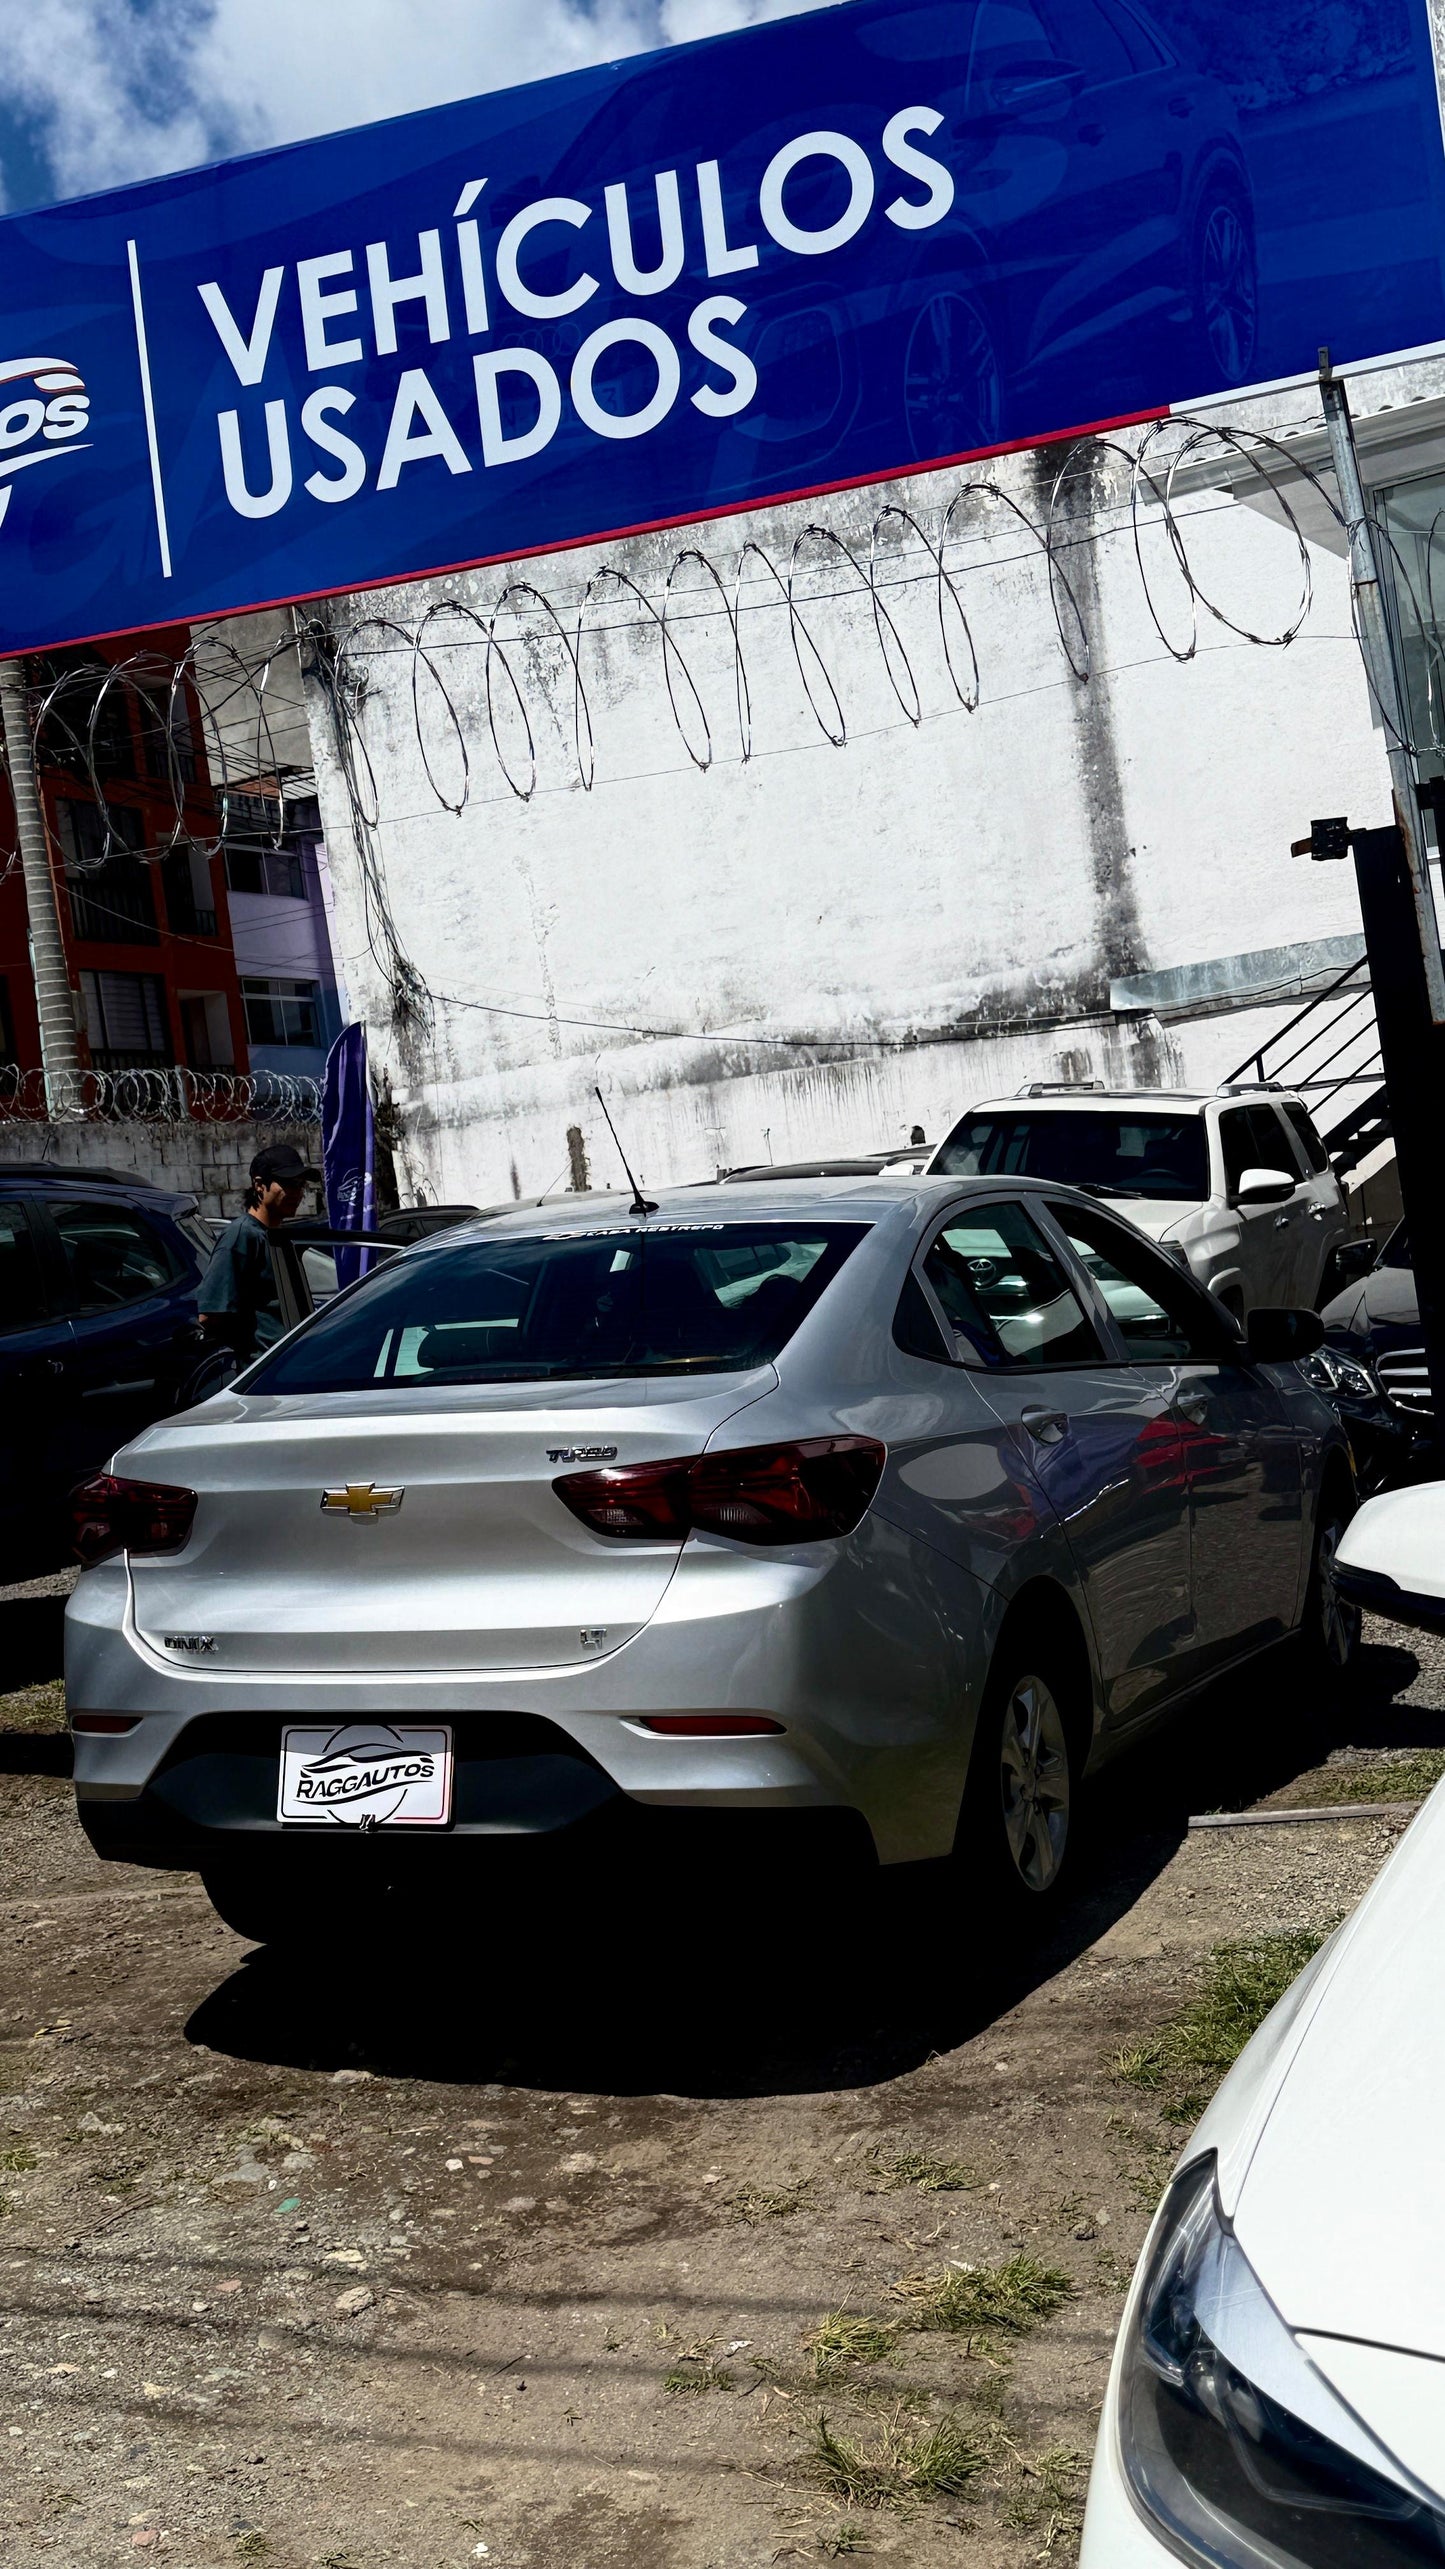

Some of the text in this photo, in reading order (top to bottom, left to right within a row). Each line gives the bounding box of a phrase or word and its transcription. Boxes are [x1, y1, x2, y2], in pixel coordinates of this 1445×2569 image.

[197, 106, 955, 387] VEHÍCULOS
[218, 296, 758, 519] USADOS
[164, 1636, 218, 1651] ONIX
[580, 1629, 607, 1649] LT
[296, 1763, 436, 1799] RAGGAUTOS
